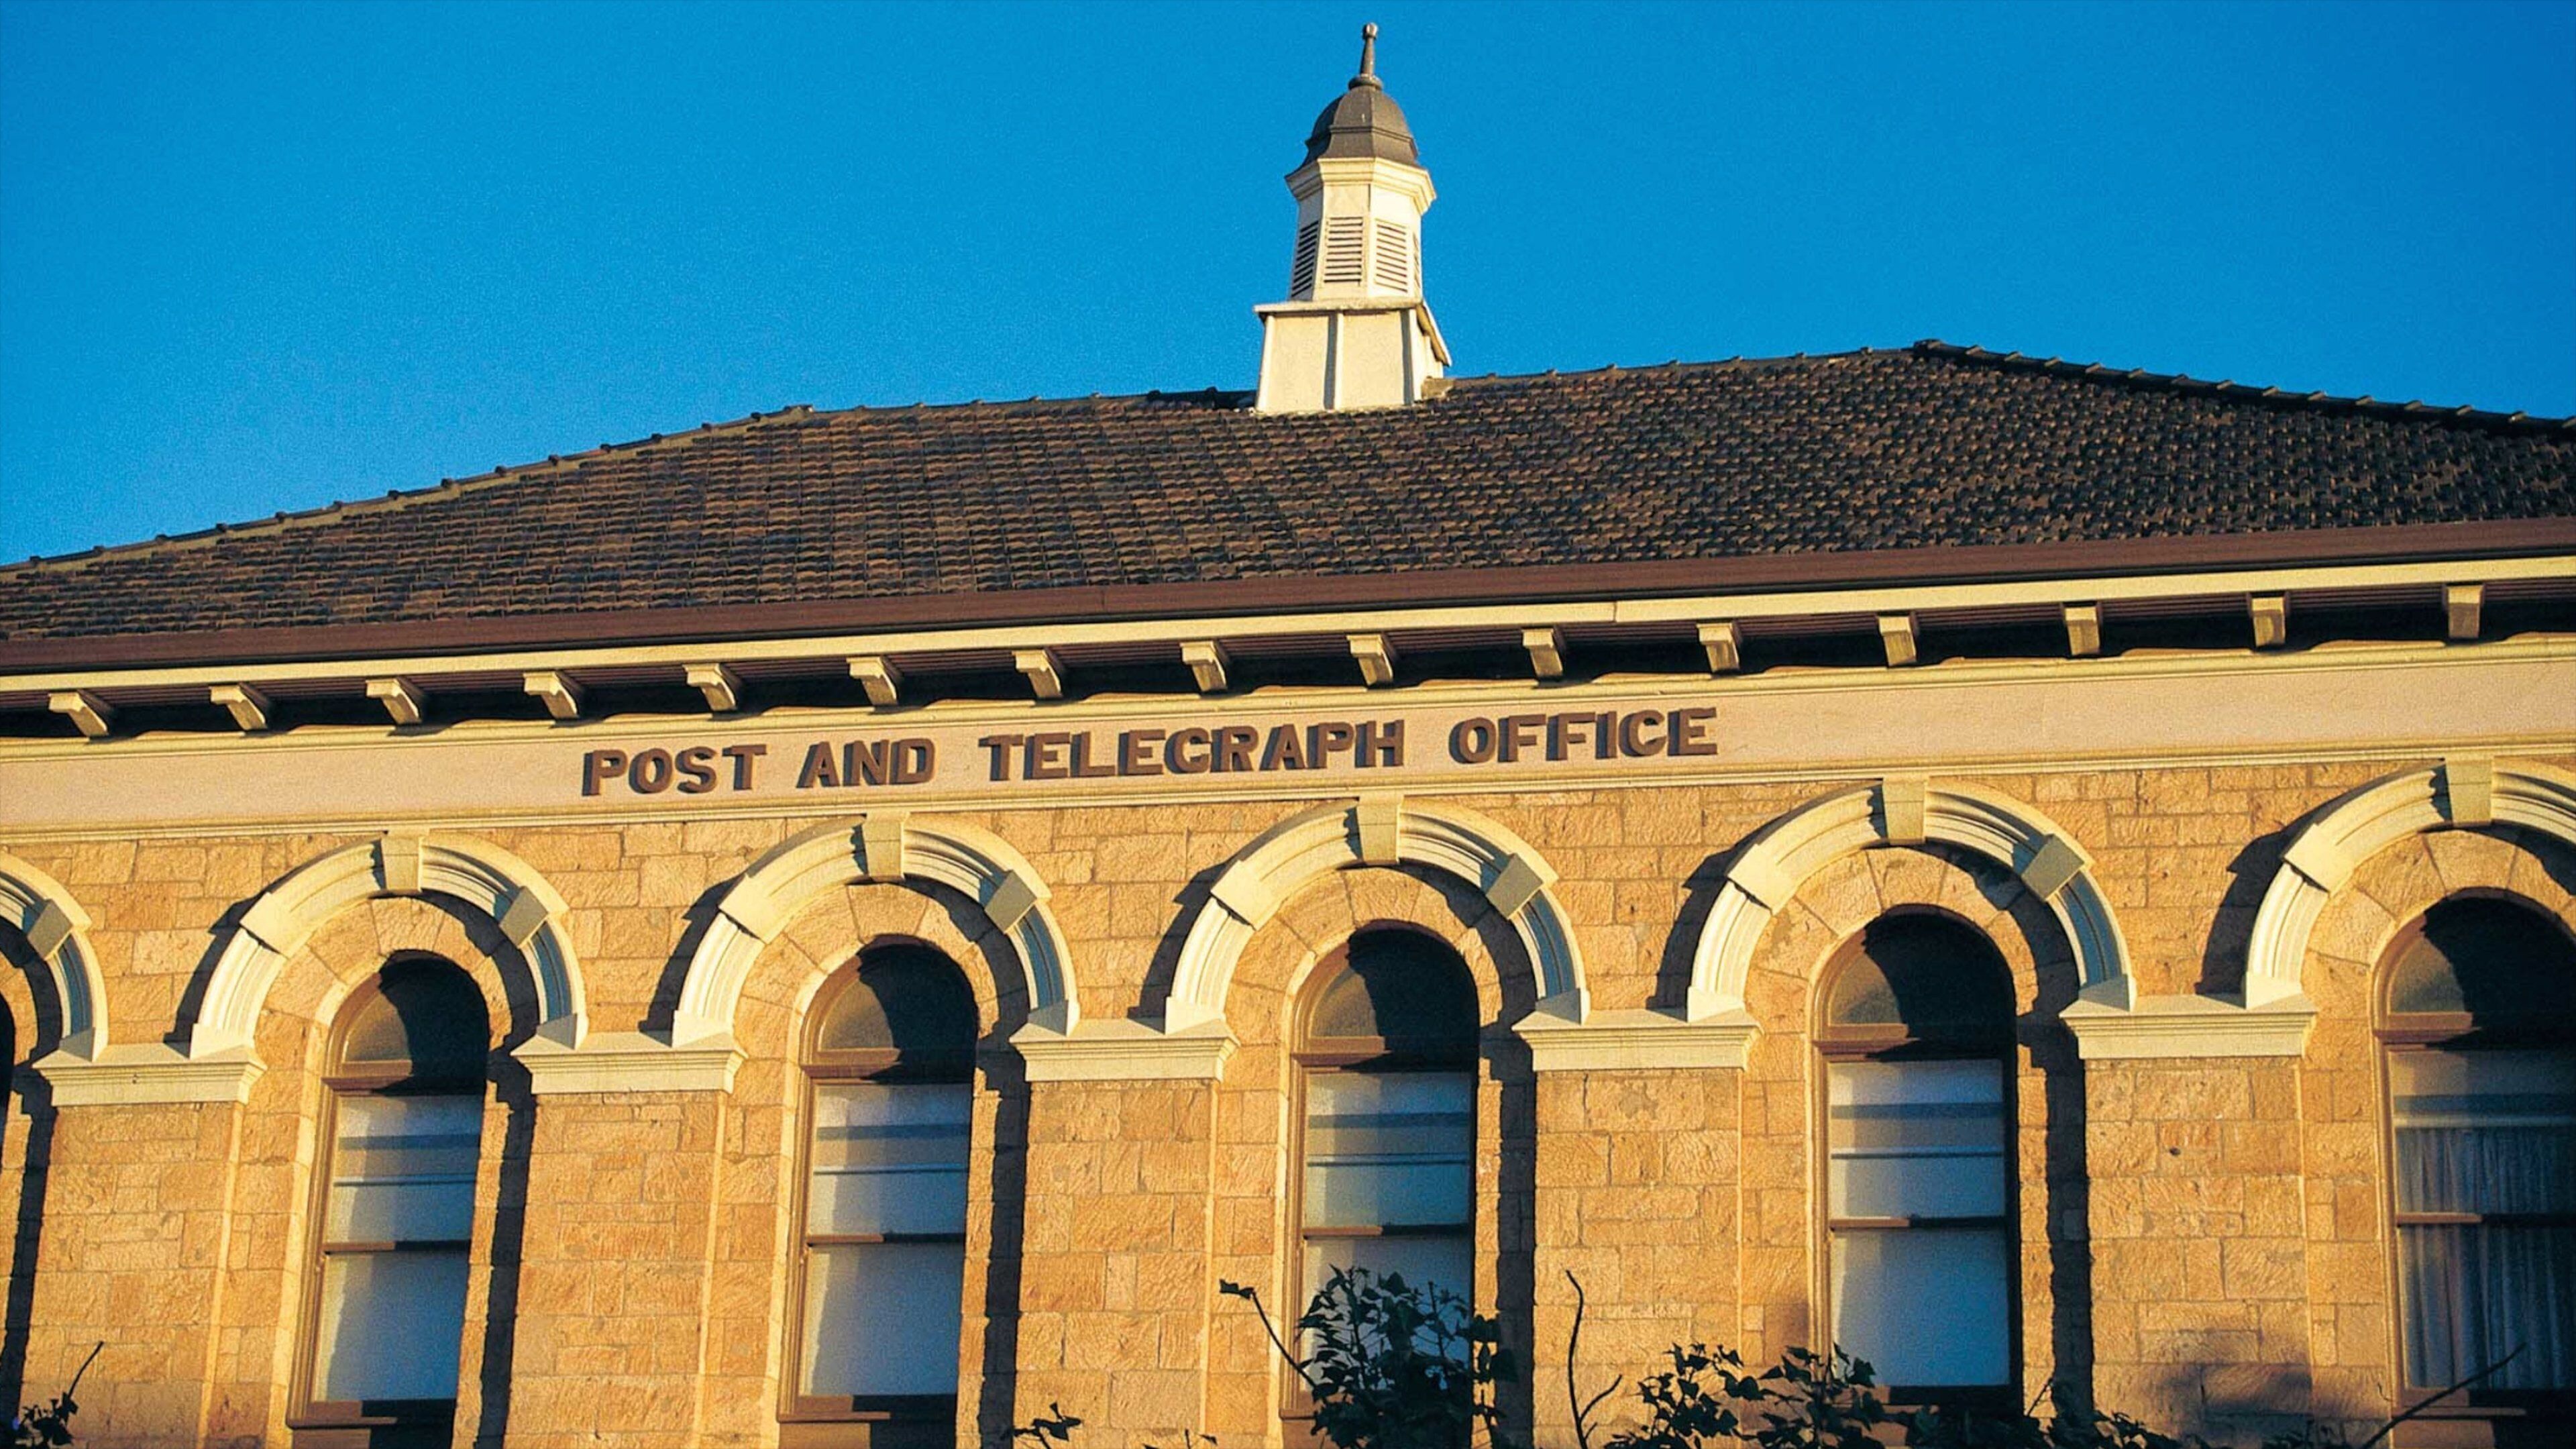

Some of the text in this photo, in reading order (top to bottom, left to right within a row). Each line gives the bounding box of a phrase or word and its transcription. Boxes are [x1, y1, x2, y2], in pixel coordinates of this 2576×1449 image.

[583, 706, 1718, 796] POST AND TELEGRAPH OFFICE
